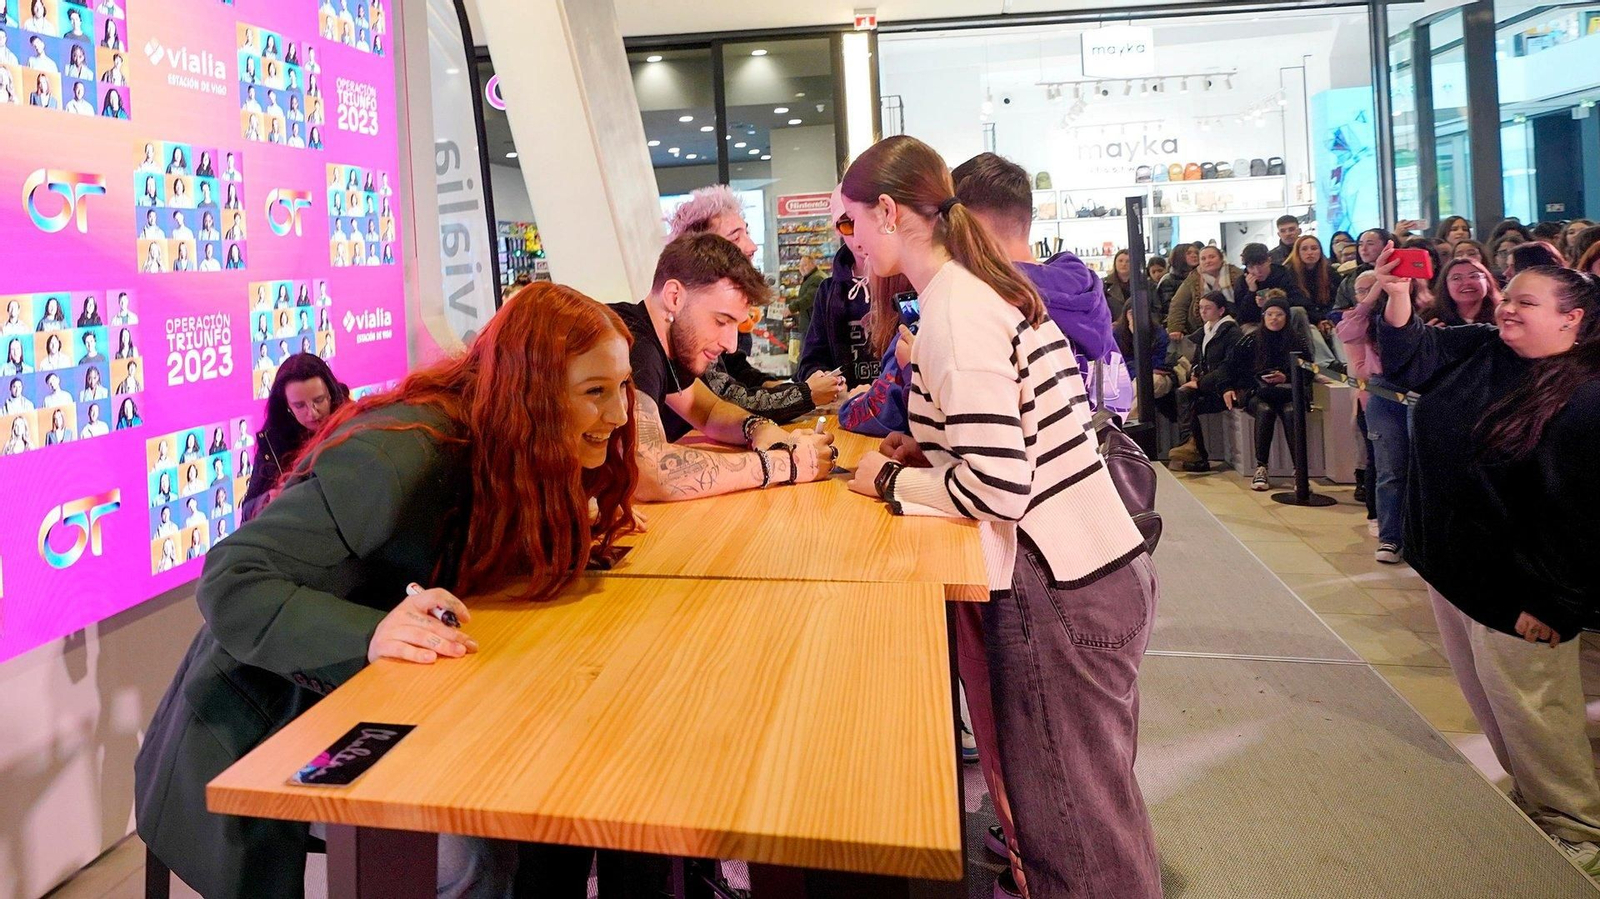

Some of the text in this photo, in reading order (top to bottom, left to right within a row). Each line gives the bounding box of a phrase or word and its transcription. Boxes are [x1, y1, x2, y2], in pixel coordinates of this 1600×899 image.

[1092, 43, 1145, 57] mayka
[166, 46, 226, 80] vialia
[201, 79, 210, 93] DE
[210, 81, 227, 96] VIGO
[336, 88, 378, 112] TRIUNFO
[337, 103, 379, 136] 2023
[1079, 135, 1178, 162] mayka
[789, 200, 828, 210] Nintendo
[165, 310, 231, 334] OPERACIÓN
[355, 307, 392, 330] vialia
[166, 327, 232, 352] TRIUNFO
[166, 345, 234, 387] 2023
